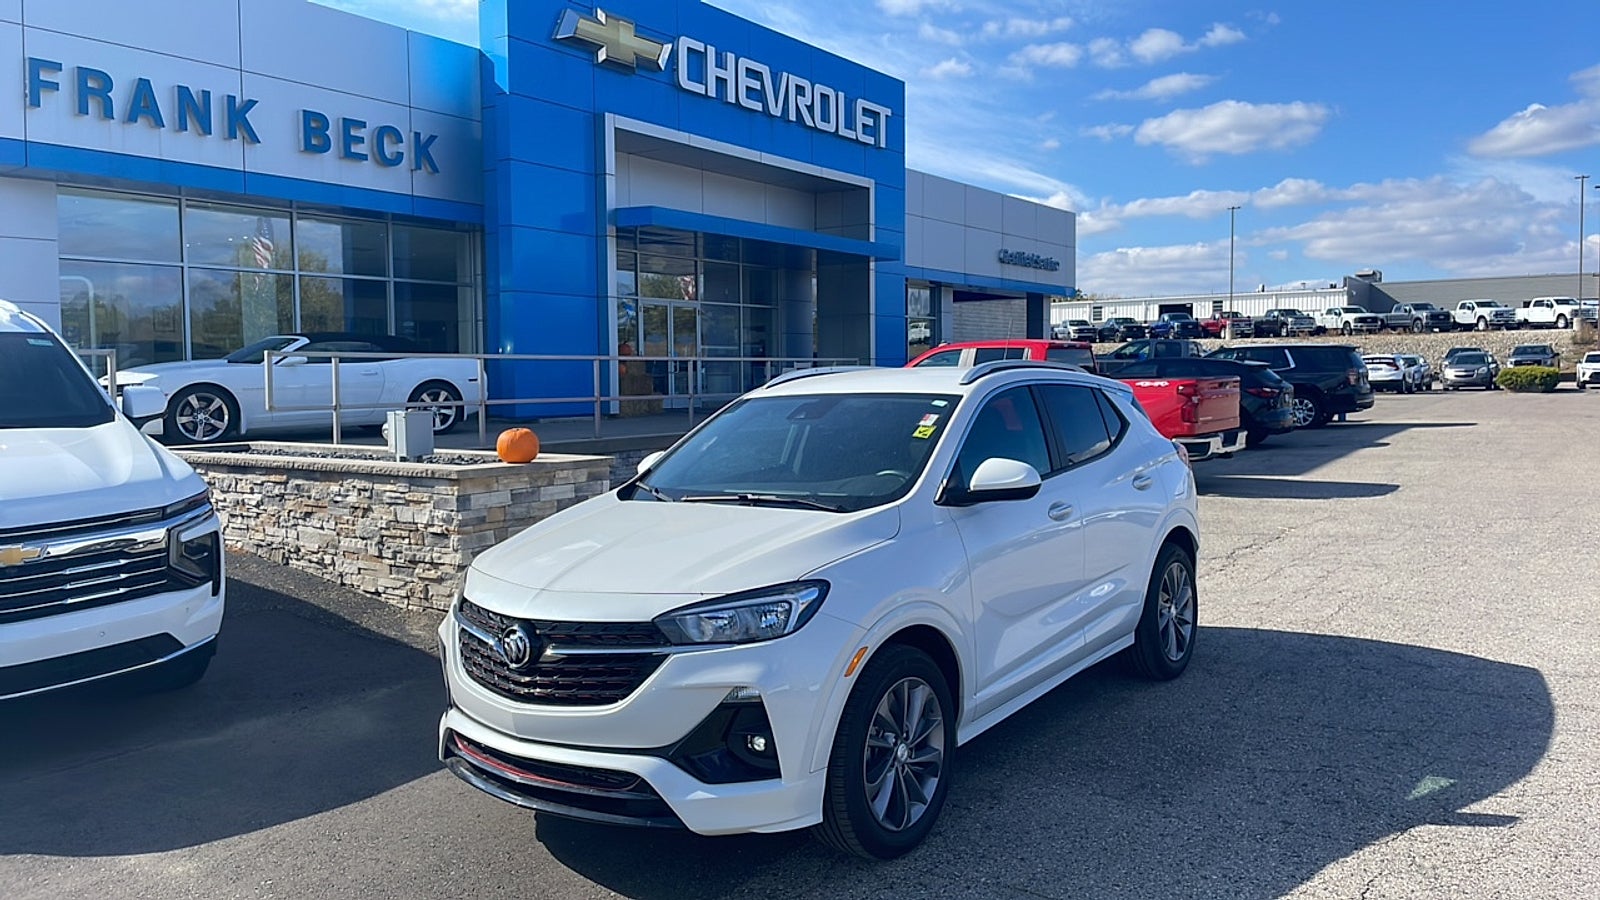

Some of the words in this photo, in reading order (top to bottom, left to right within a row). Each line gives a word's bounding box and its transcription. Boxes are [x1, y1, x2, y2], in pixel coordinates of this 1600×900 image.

[27, 57, 261, 144] FRANK
[299, 109, 441, 174] BECK
[678, 36, 892, 149] CHEVROLET
